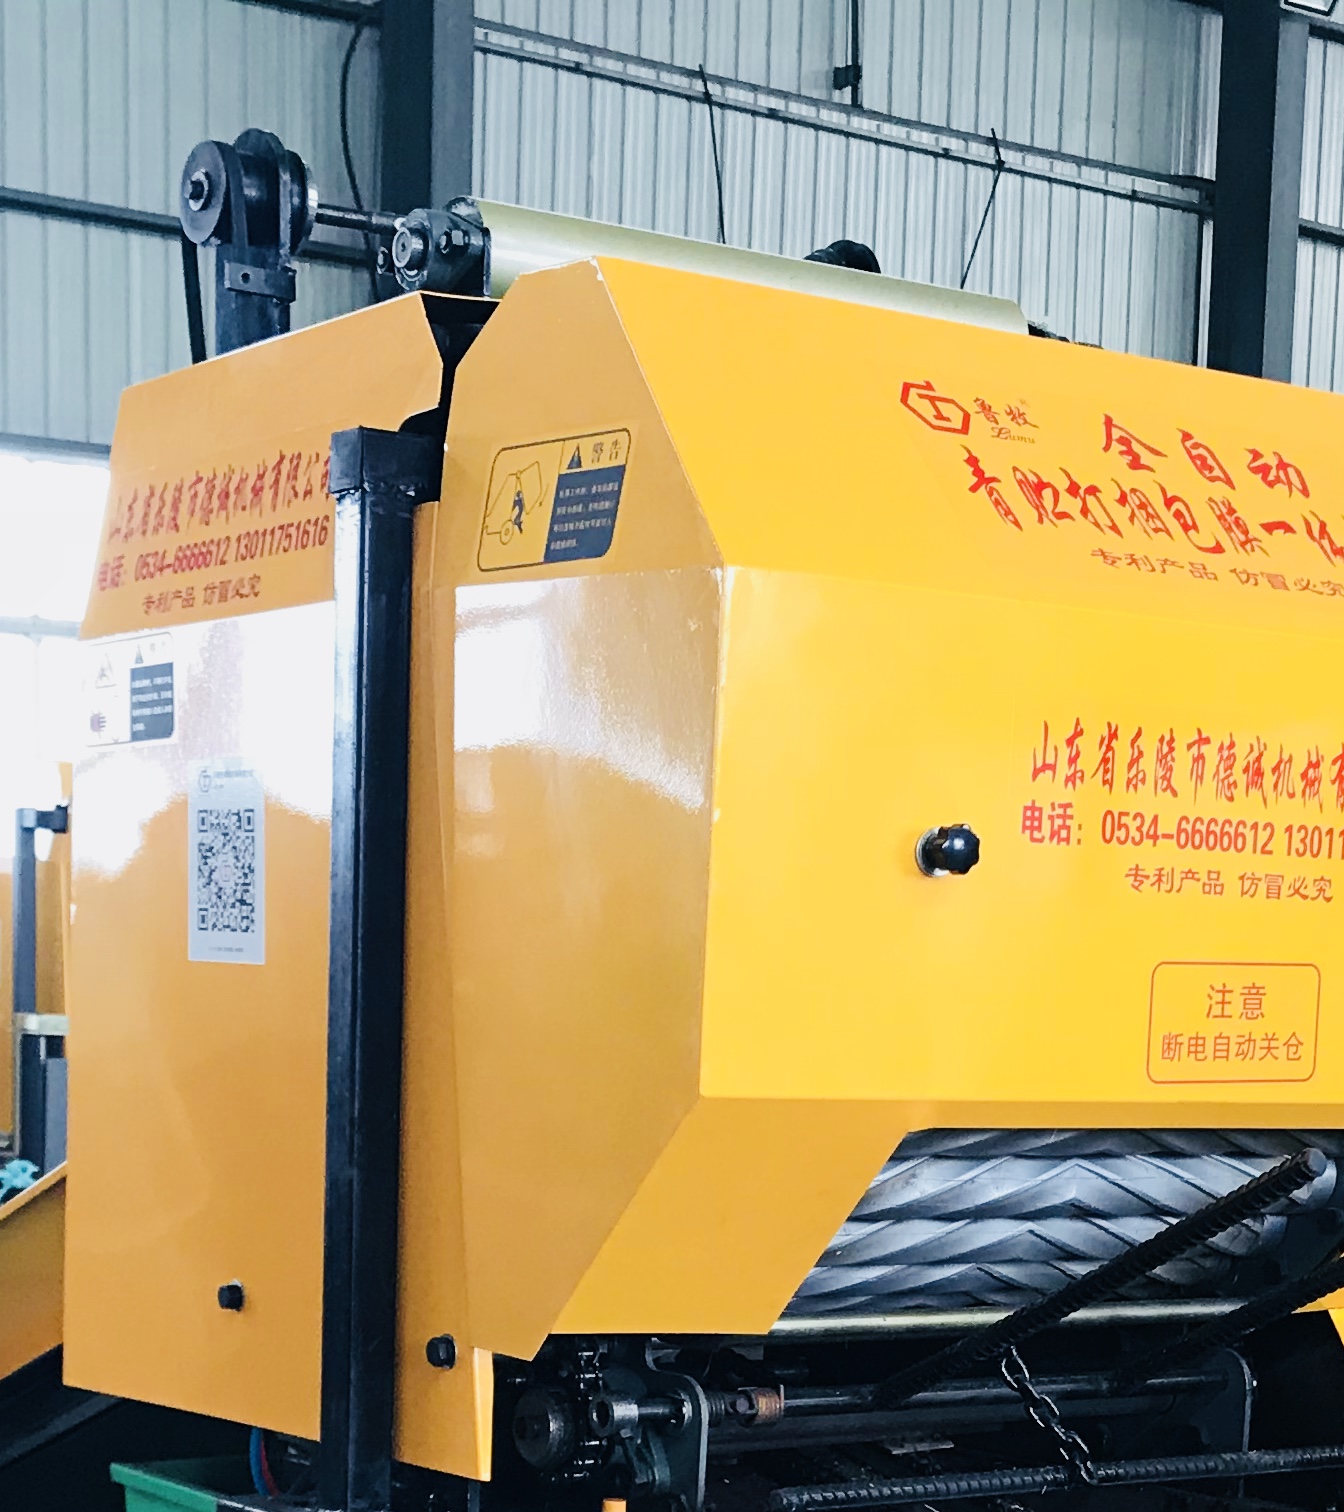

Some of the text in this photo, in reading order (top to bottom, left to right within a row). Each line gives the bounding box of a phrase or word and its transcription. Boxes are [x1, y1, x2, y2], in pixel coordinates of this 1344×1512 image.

[1102, 413, 1311, 499] 全自动
[234, 515, 331, 562] 13011751616
[1091, 548, 1218, 581] 专利产品
[1101, 809, 1274, 856] 0534-6666612
[1124, 863, 1334, 903] 专利产品 仿冒必究
[1205, 982, 1267, 1020] 注意
[1161, 1031, 1304, 1062] 断电自动关仓
